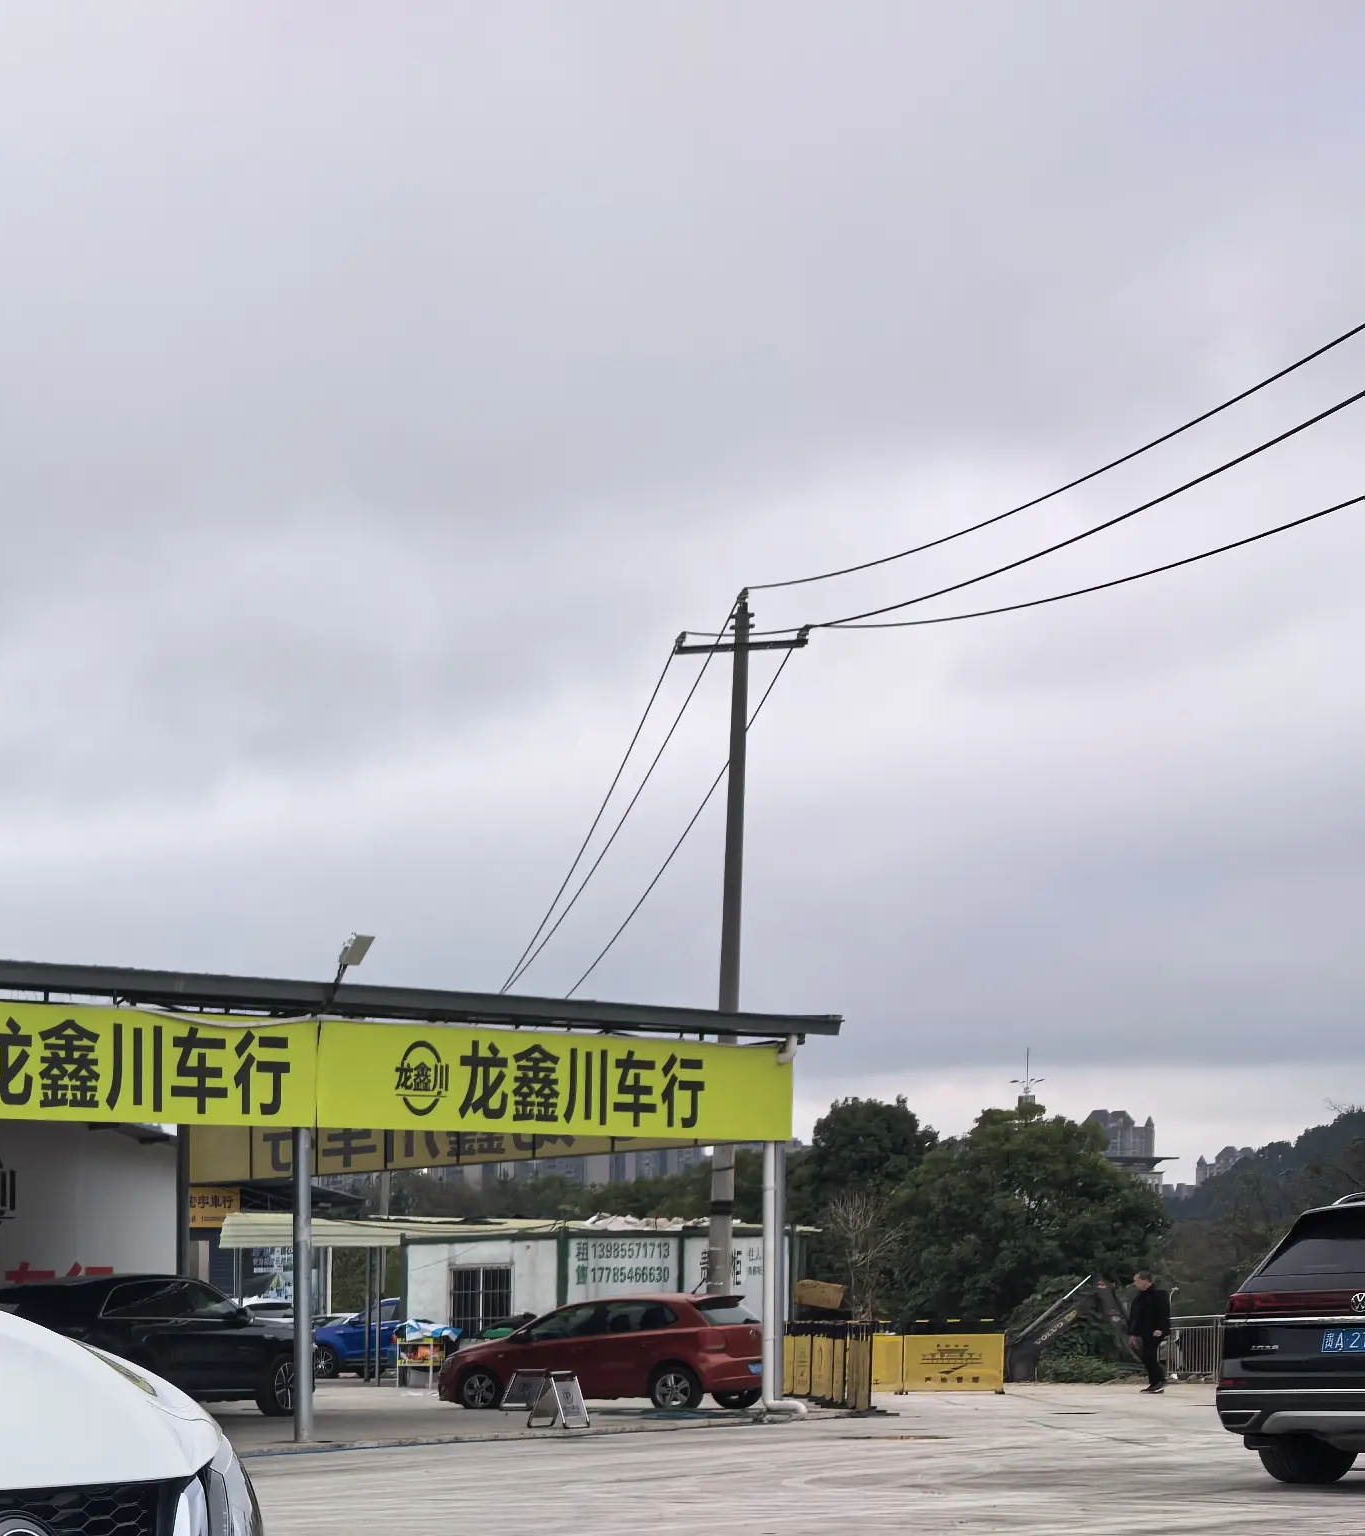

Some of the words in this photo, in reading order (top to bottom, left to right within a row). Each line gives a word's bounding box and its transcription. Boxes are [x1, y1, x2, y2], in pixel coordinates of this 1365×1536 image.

[394, 1061, 450, 1093] 龙鑫川
[459, 1040, 705, 1128] 龙鑫川车行
[1323, 1330, 1365, 1352] 贵A·2
